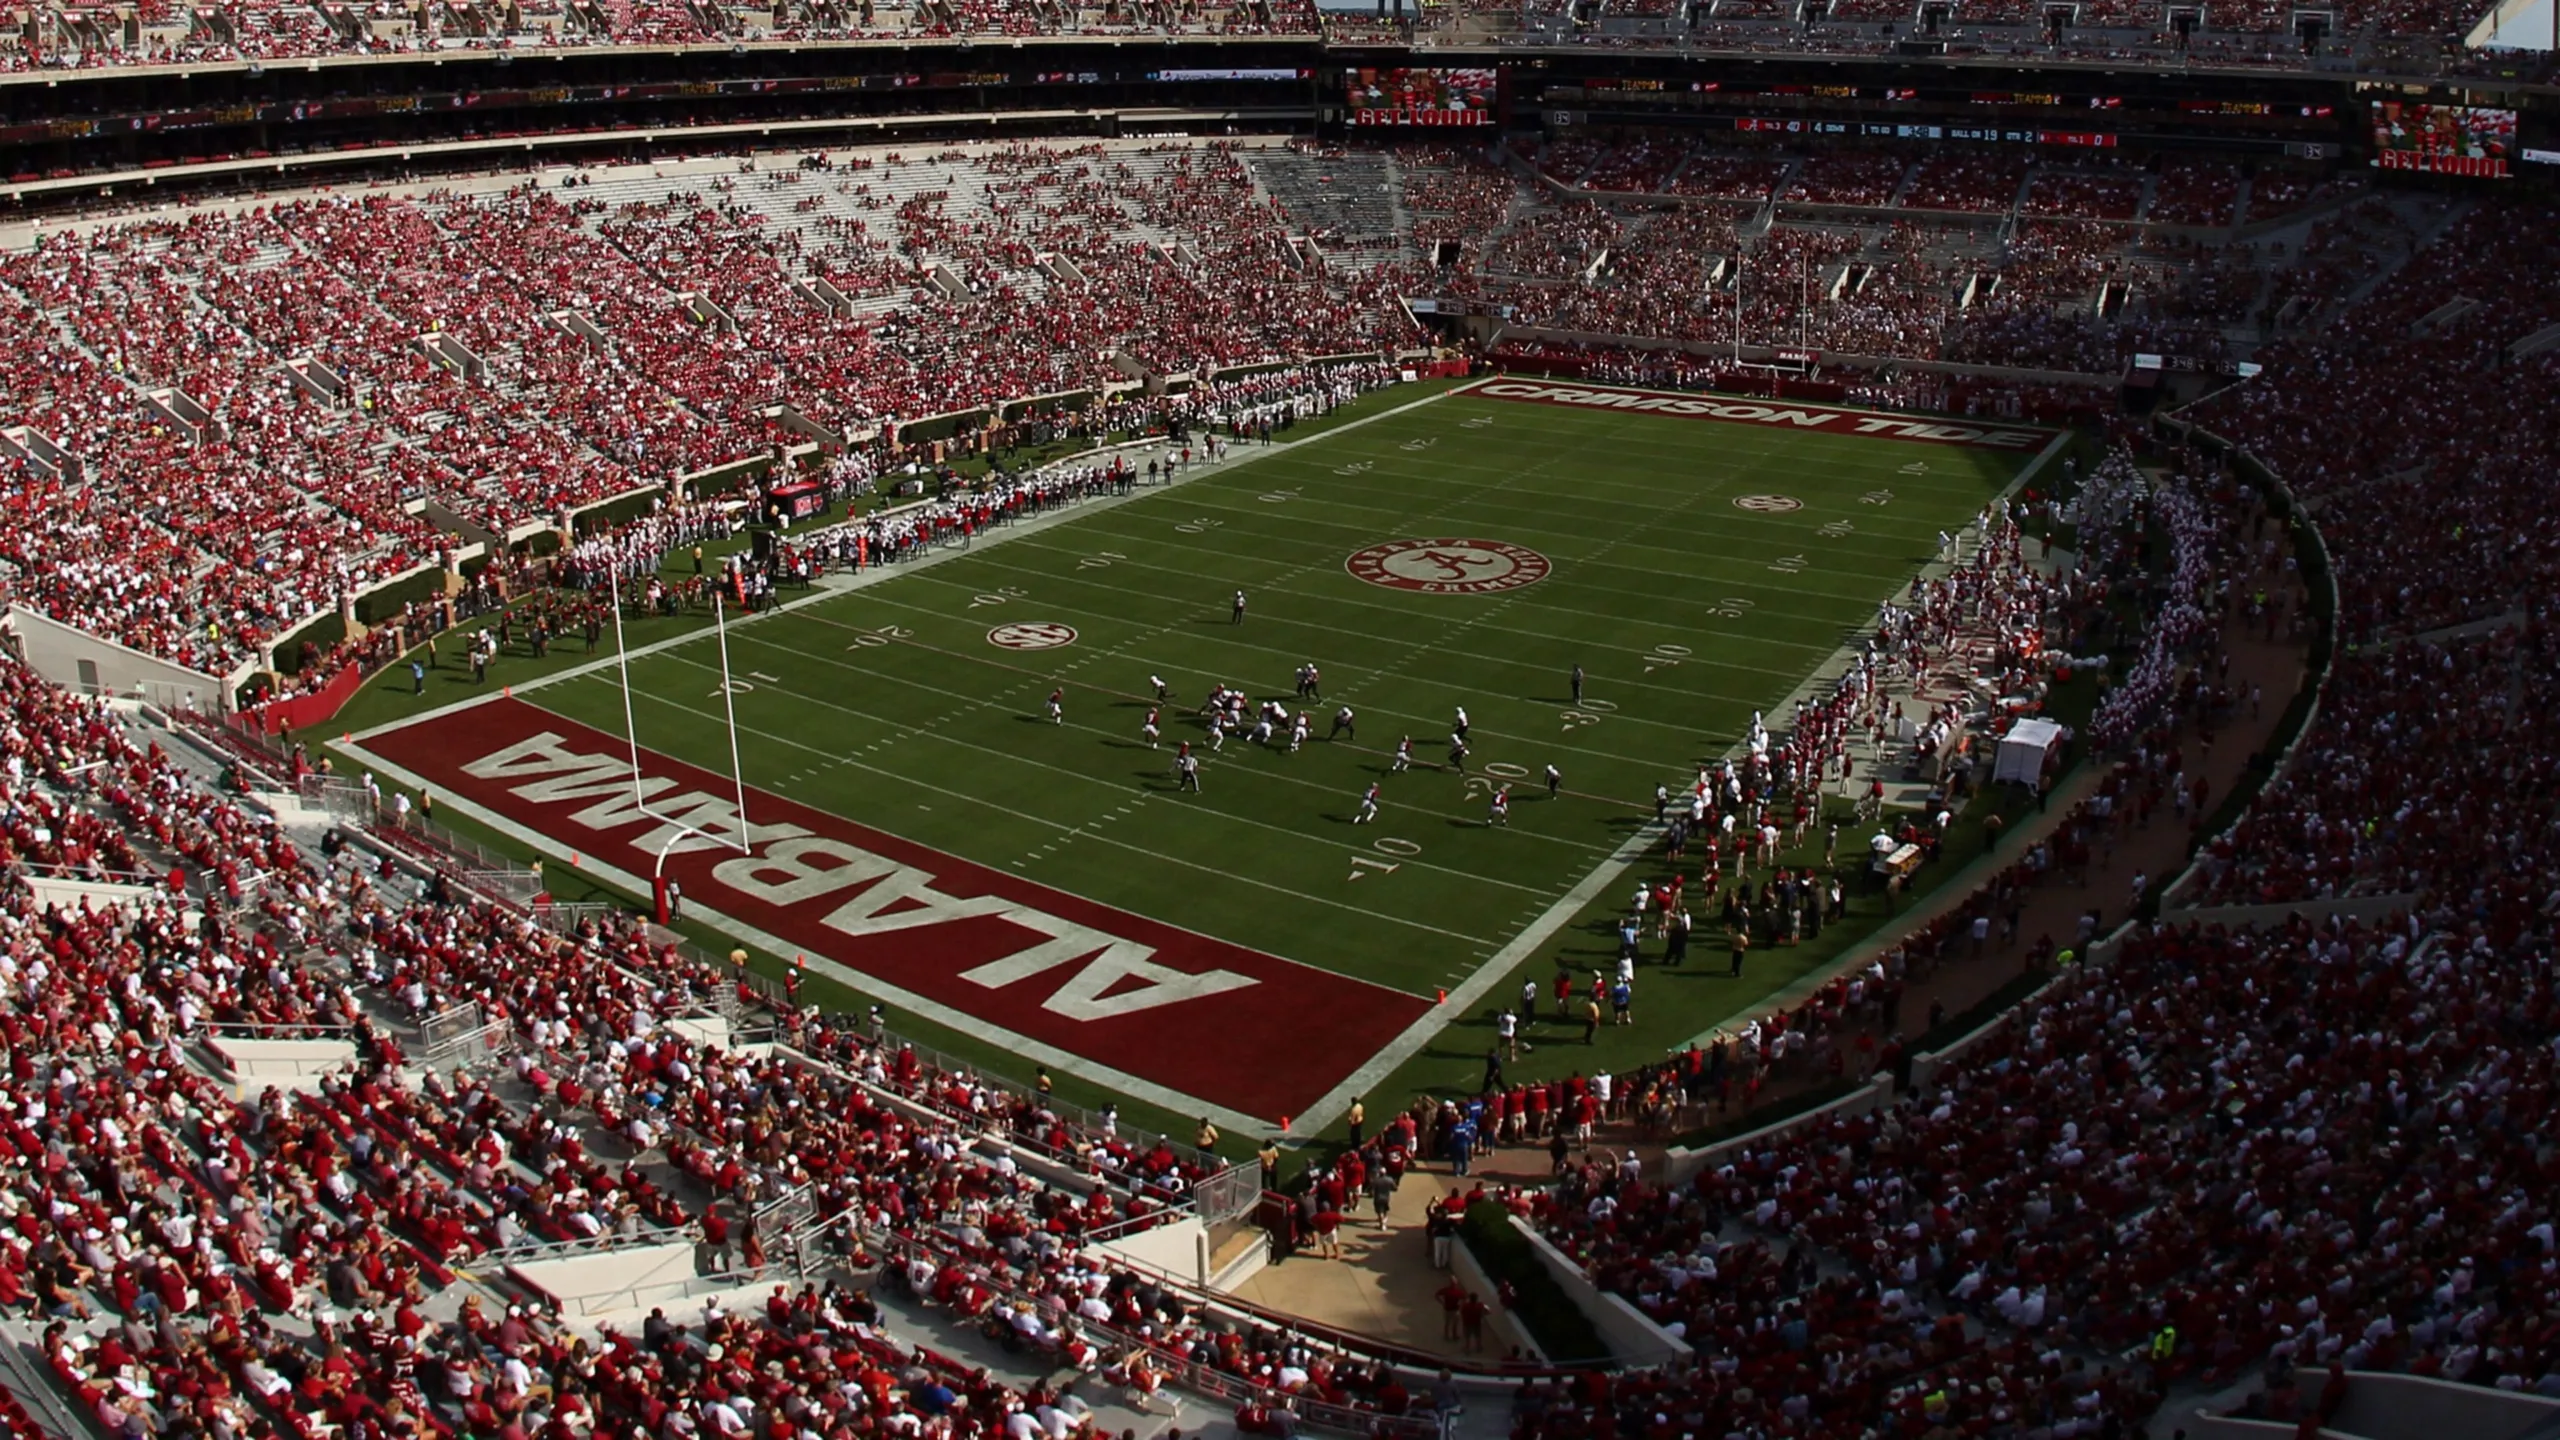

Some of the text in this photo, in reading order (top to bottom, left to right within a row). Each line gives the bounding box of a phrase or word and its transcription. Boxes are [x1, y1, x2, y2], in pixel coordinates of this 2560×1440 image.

[1355, 108, 1404, 126] GET
[1814, 122, 1822, 133] 4
[1951, 129, 1969, 138] BALL
[1983, 129, 1998, 141] 19
[2024, 131, 2033, 142] 2
[2379, 148, 2425, 171] GET
[1480, 384, 1840, 427] CRIMSON
[1854, 416, 2044, 448] TIDE
[1965, 395, 2023, 418] TDE
[1353, 539, 1471, 584] ALABAMA
[855, 625, 915, 647] 20
[992, 625, 1071, 649] SEC
[1559, 699, 1619, 725] 30
[1463, 762, 1530, 795] 20
[1350, 837, 1422, 875] 10
[458, 730, 1262, 1022] ALABAMA
